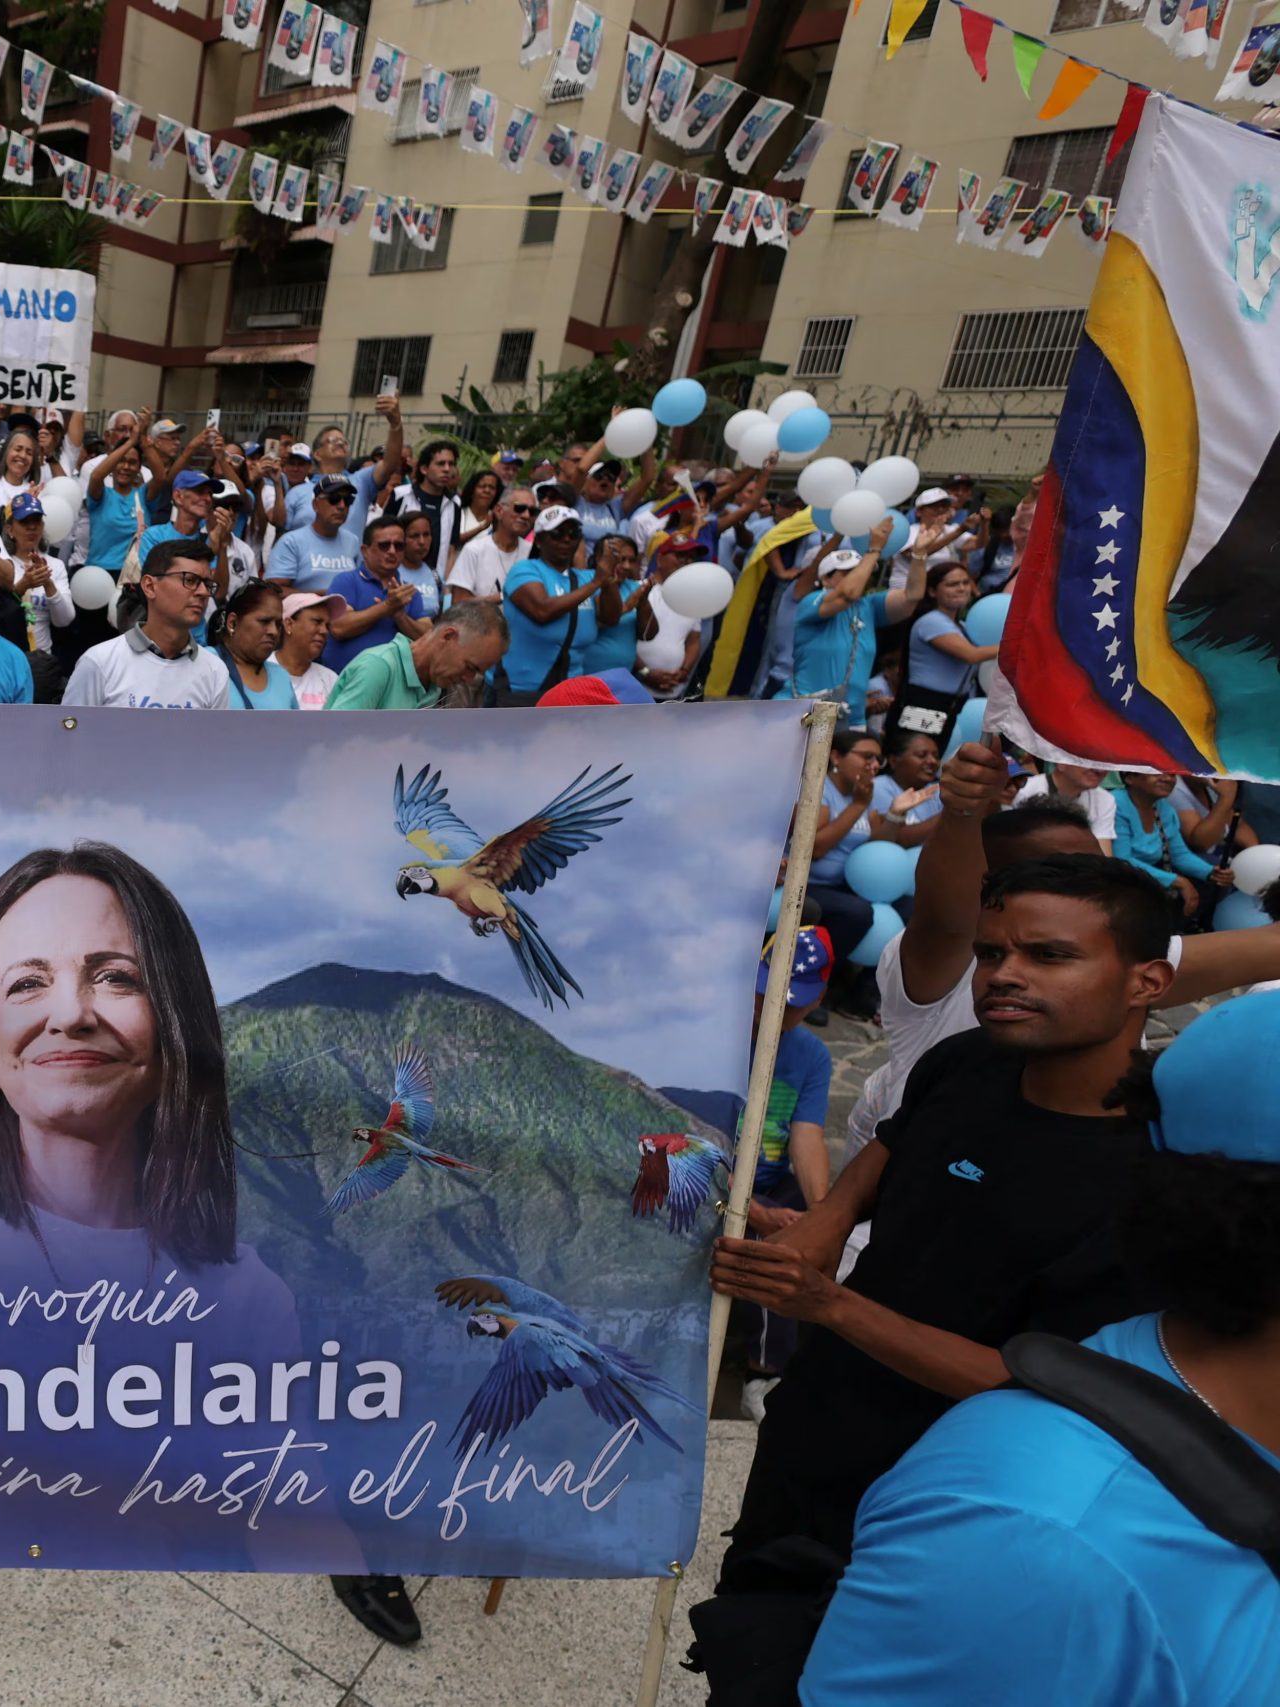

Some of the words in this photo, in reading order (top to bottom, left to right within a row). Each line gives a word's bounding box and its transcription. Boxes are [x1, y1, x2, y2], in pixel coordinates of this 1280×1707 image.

[118, 1429, 328, 1530] hasta
[348, 1421, 437, 1520] el
[438, 1418, 639, 1541] final
